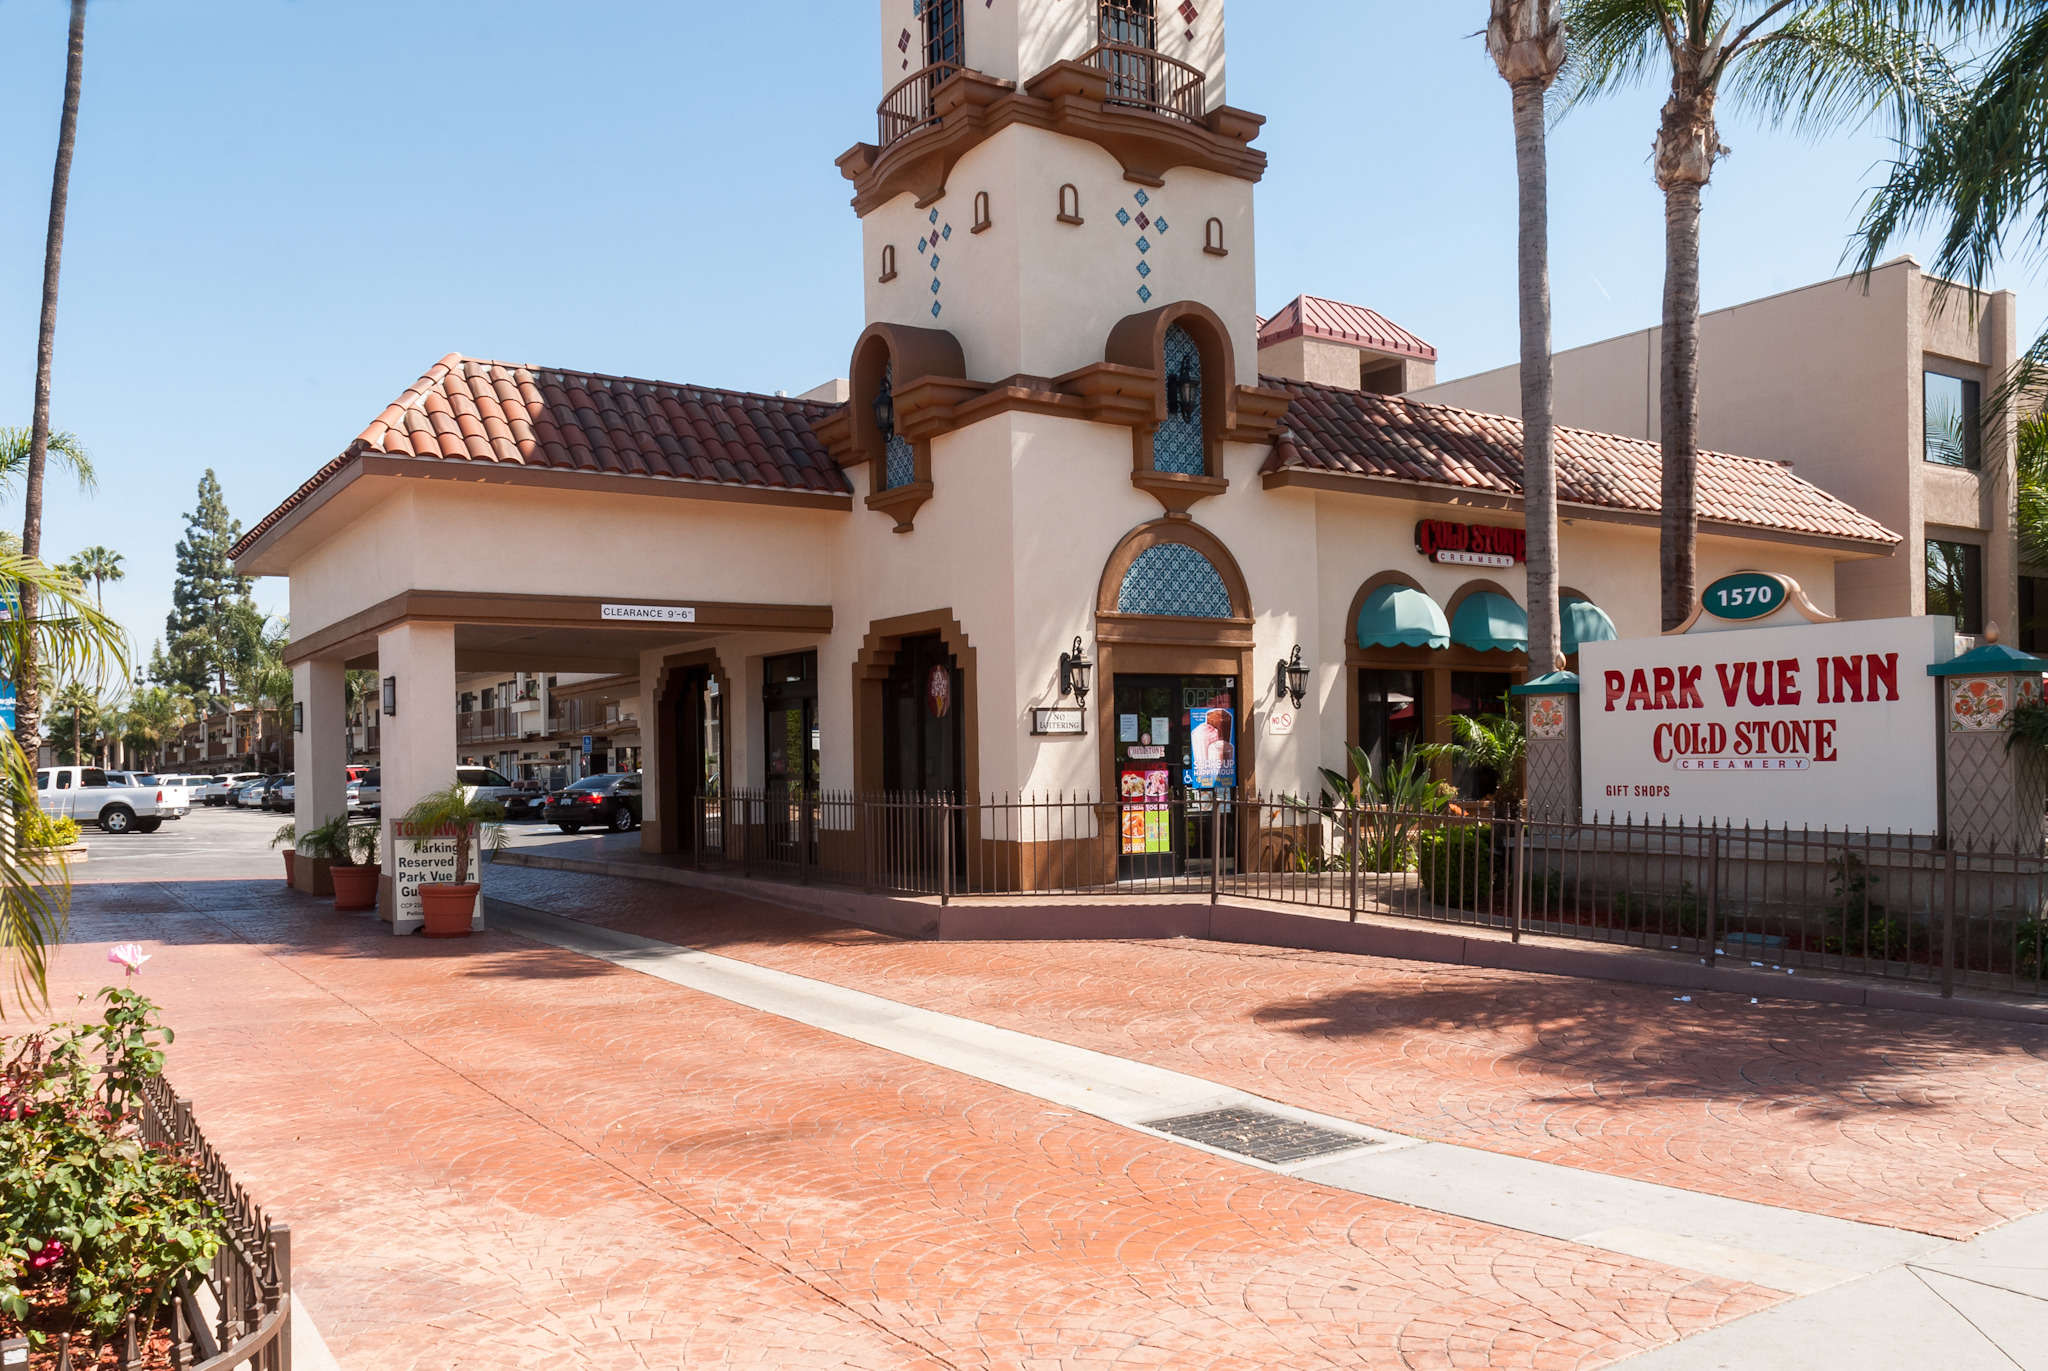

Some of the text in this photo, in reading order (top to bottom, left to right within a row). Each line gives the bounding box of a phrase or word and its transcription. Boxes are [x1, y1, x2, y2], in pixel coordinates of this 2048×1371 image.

[1421, 519, 1469, 554] COLD
[1440, 553, 1511, 565] CREAMERY
[1717, 586, 1772, 607] 1570
[603, 607, 663, 617] CLEARANCE
[1604, 653, 1900, 712] PARK VUE INN
[1653, 719, 1838, 763] COLD STONE
[1224, 759, 1235, 769] UP
[1682, 760, 1803, 769] CREAMERY
[1606, 785, 1670, 797] GIFT SHOPS
[399, 856, 454, 868] Reserved
[399, 871, 426, 882] Park
[430, 871, 453, 881] Vue
